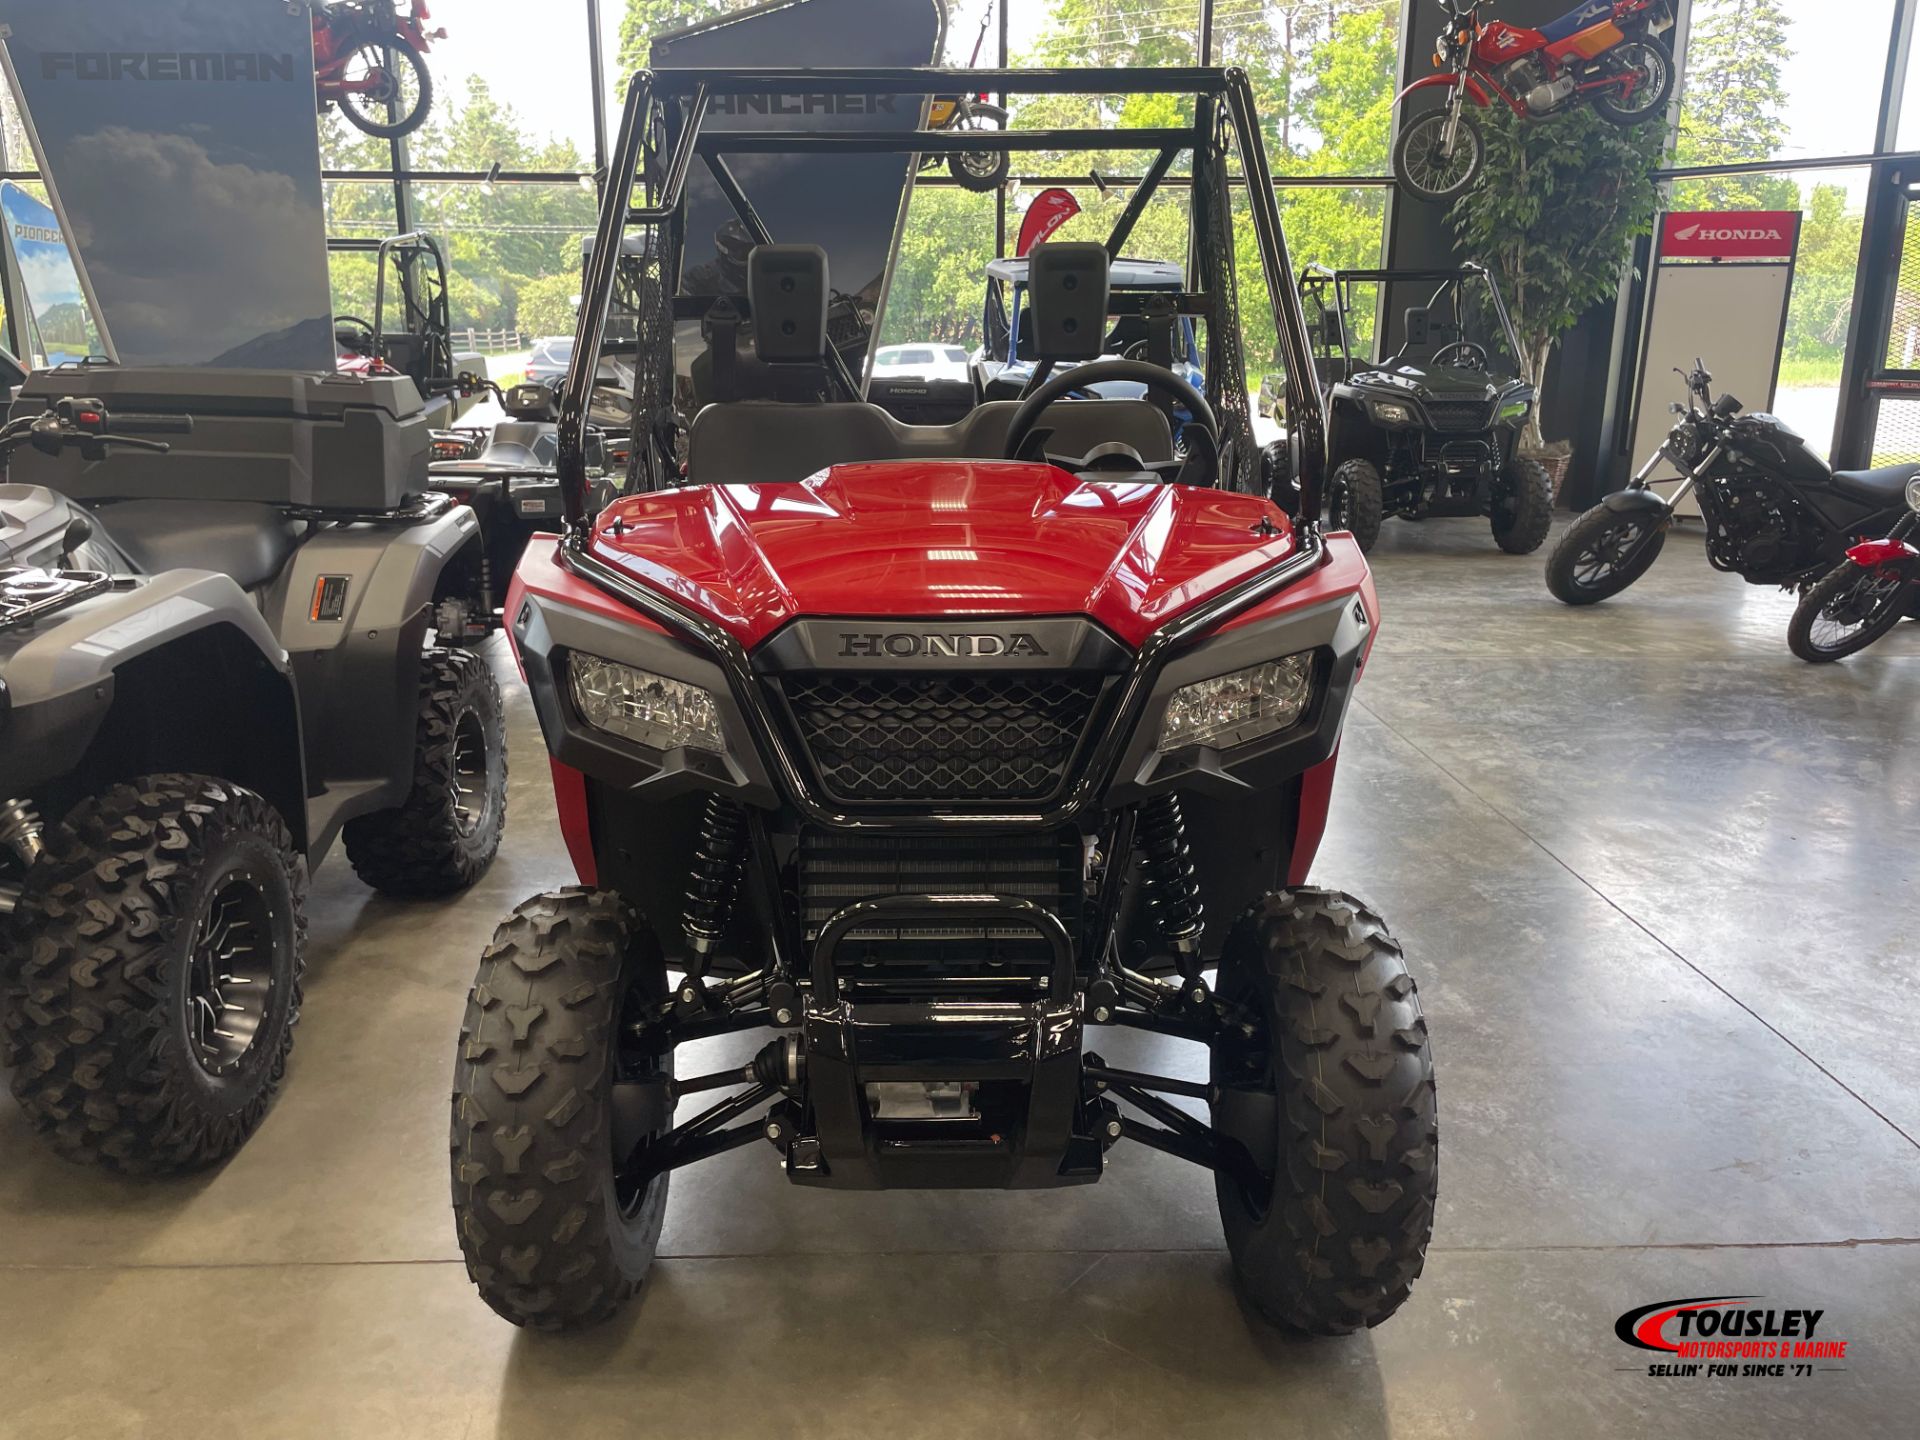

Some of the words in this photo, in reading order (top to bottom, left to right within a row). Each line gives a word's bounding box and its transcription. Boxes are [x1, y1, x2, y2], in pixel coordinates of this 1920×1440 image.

[1576, 2, 1610, 26] XL
[40, 52, 293, 82] FOREMAN
[687, 93, 897, 115] ANCHER
[1698, 229, 1782, 240] HONDA
[838, 633, 1049, 657] HONDA
